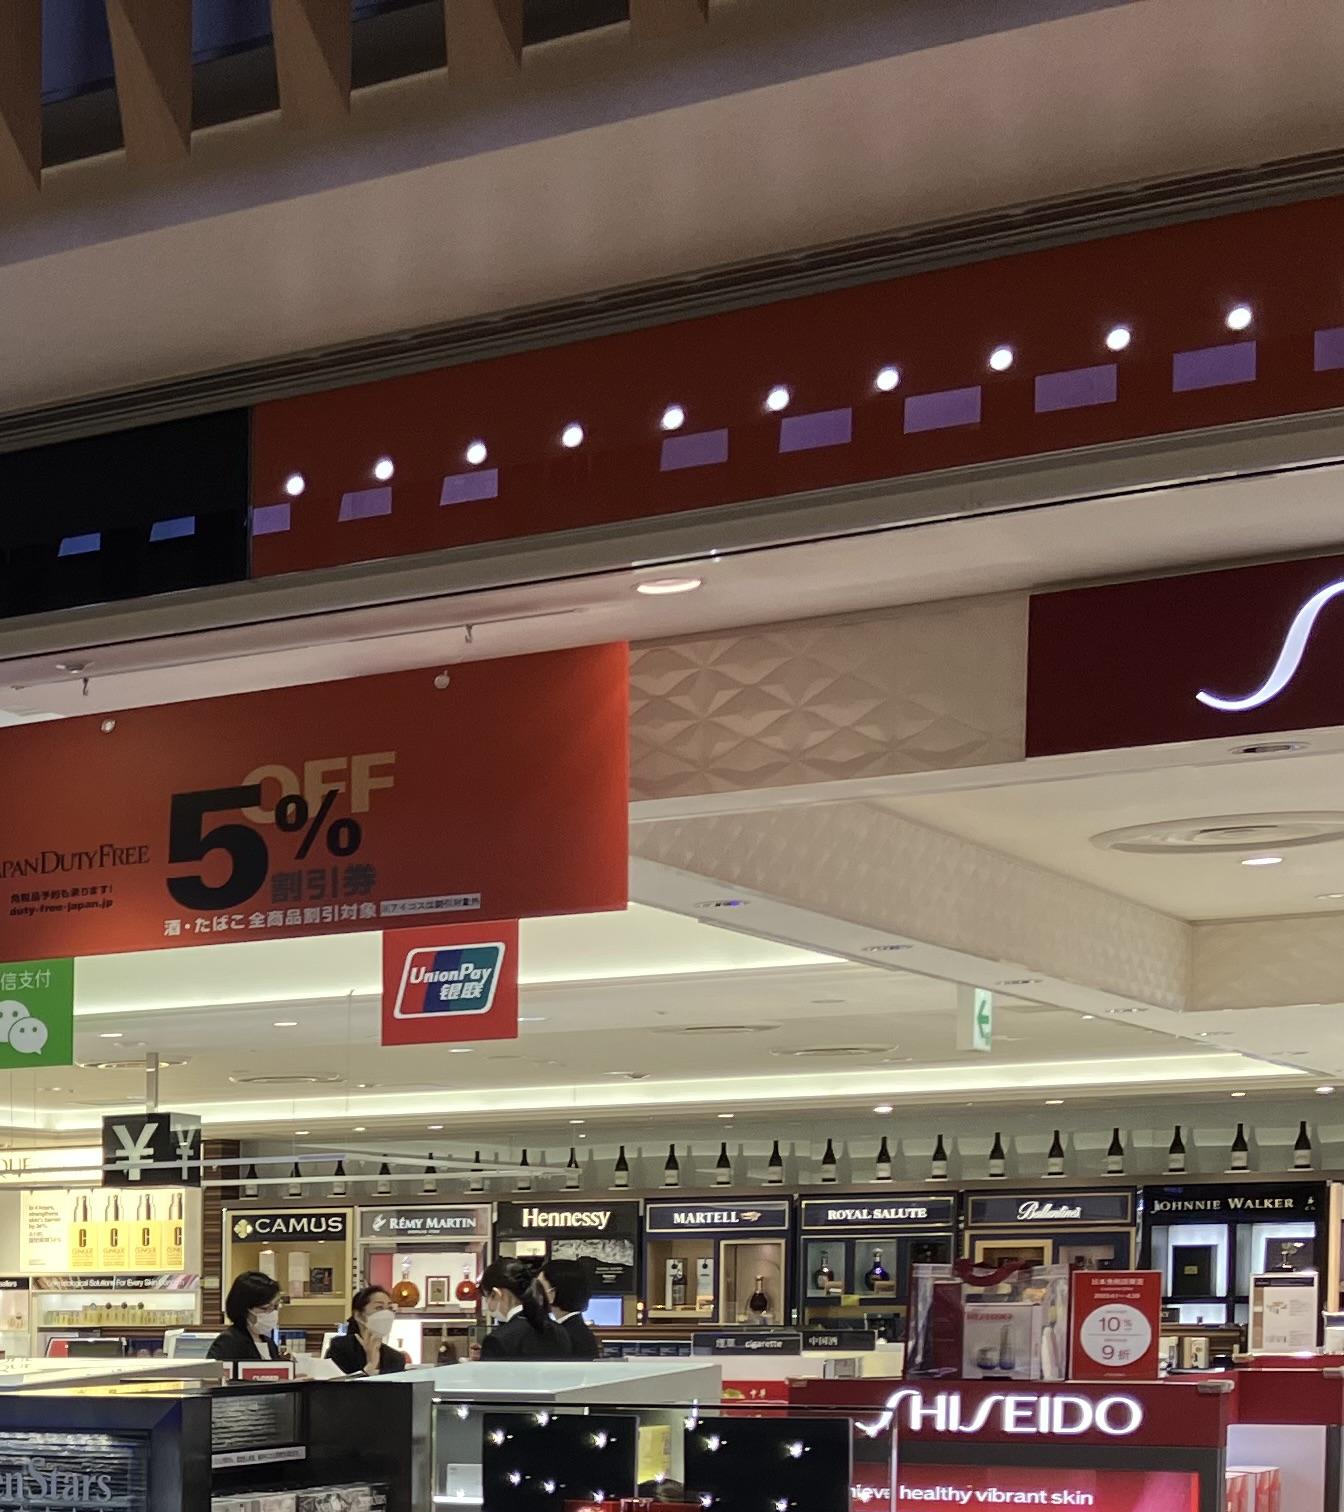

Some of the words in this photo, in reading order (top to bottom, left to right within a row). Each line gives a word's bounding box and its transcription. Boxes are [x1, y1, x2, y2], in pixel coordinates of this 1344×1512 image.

[241, 751, 396, 824] OFF
[271, 864, 376, 904] 割引券
[9, 899, 114, 916] duty-free-japan.jp
[410, 963, 492, 990] UnionPay
[440, 983, 484, 1001] 银联
[827, 1207, 870, 1222] ROYAL
[873, 1205, 927, 1221] SALUTE
[1150, 1199, 1221, 1214] JOHNNIE
[1228, 1197, 1295, 1211] WALKER
[255, 1215, 343, 1234] CAMUS
[389, 1217, 424, 1230] RÉMY
[425, 1217, 477, 1229] MARTIN
[522, 1208, 611, 1230] Hennessy
[673, 1211, 739, 1225] MARTELL
[126, 1279, 143, 1289] Every
[1099, 1316, 1121, 1332] 10
[744, 1339, 783, 1350] cigarette
[855, 1388, 1144, 1438] SHISEIDO
[899, 1485, 972, 1505] healthy
[975, 1487, 1048, 1505] vibrant
[1050, 1490, 1094, 1506] skin
